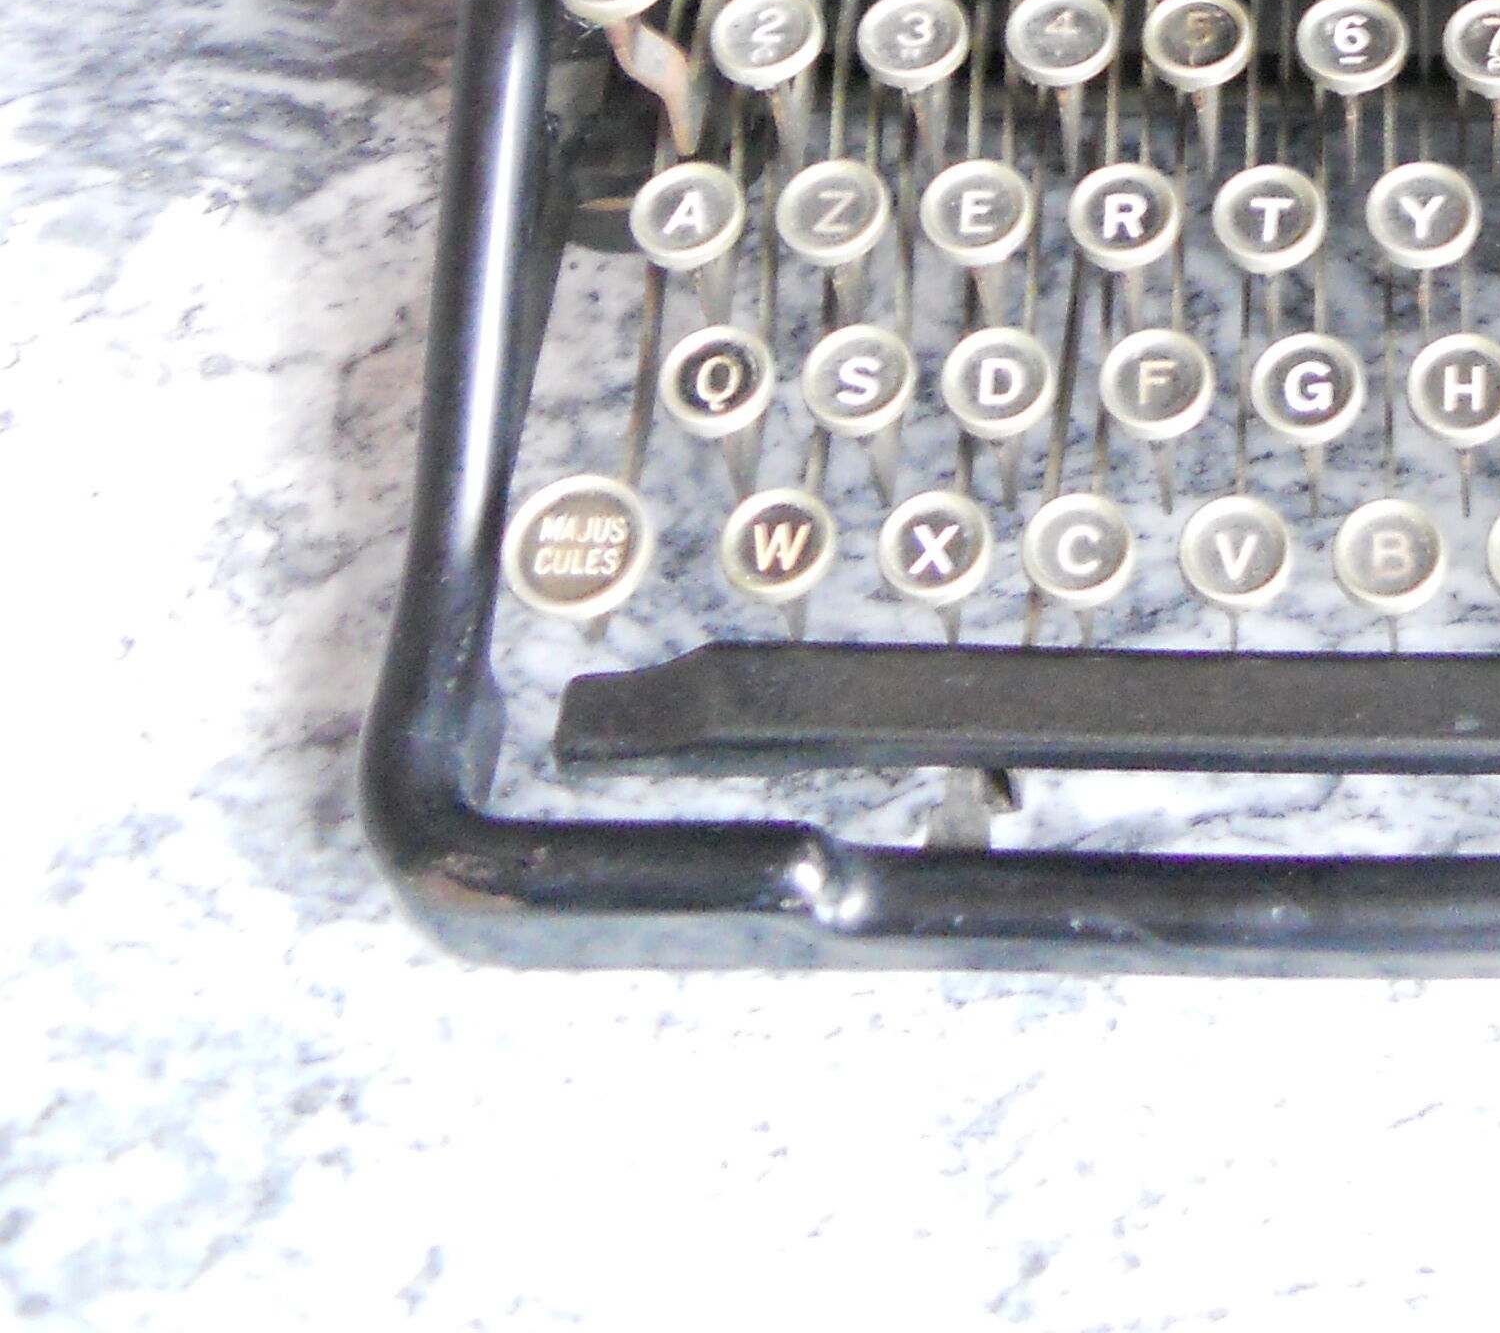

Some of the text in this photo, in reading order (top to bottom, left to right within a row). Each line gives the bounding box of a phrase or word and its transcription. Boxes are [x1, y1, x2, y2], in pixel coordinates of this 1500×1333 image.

[751, 7, 788, 43] 2
[897, 10, 939, 45] 3
[1044, 9, 1081, 37] 4
[1333, 15, 1370, 53] 6
[661, 191, 704, 234] A
[811, 189, 858, 233] Z
[957, 189, 997, 234] E
[1101, 192, 1149, 239] R
[1250, 197, 1295, 242] T
[1399, 195, 1448, 239] Y
[696, 355, 742, 411] Q
[837, 356, 883, 406] S
[977, 357, 1026, 406] D
[1137, 359, 1180, 406] F
[1284, 360, 1335, 413] G
[1443, 363, 1485, 413] H
[539, 513, 627, 545] MAJUS
[753, 522, 812, 572] W
[907, 523, 960, 575] X
[1056, 524, 1101, 575] C
[1215, 532, 1259, 583] V
[1371, 528, 1413, 579] B
[533, 545, 623, 577] CULES
